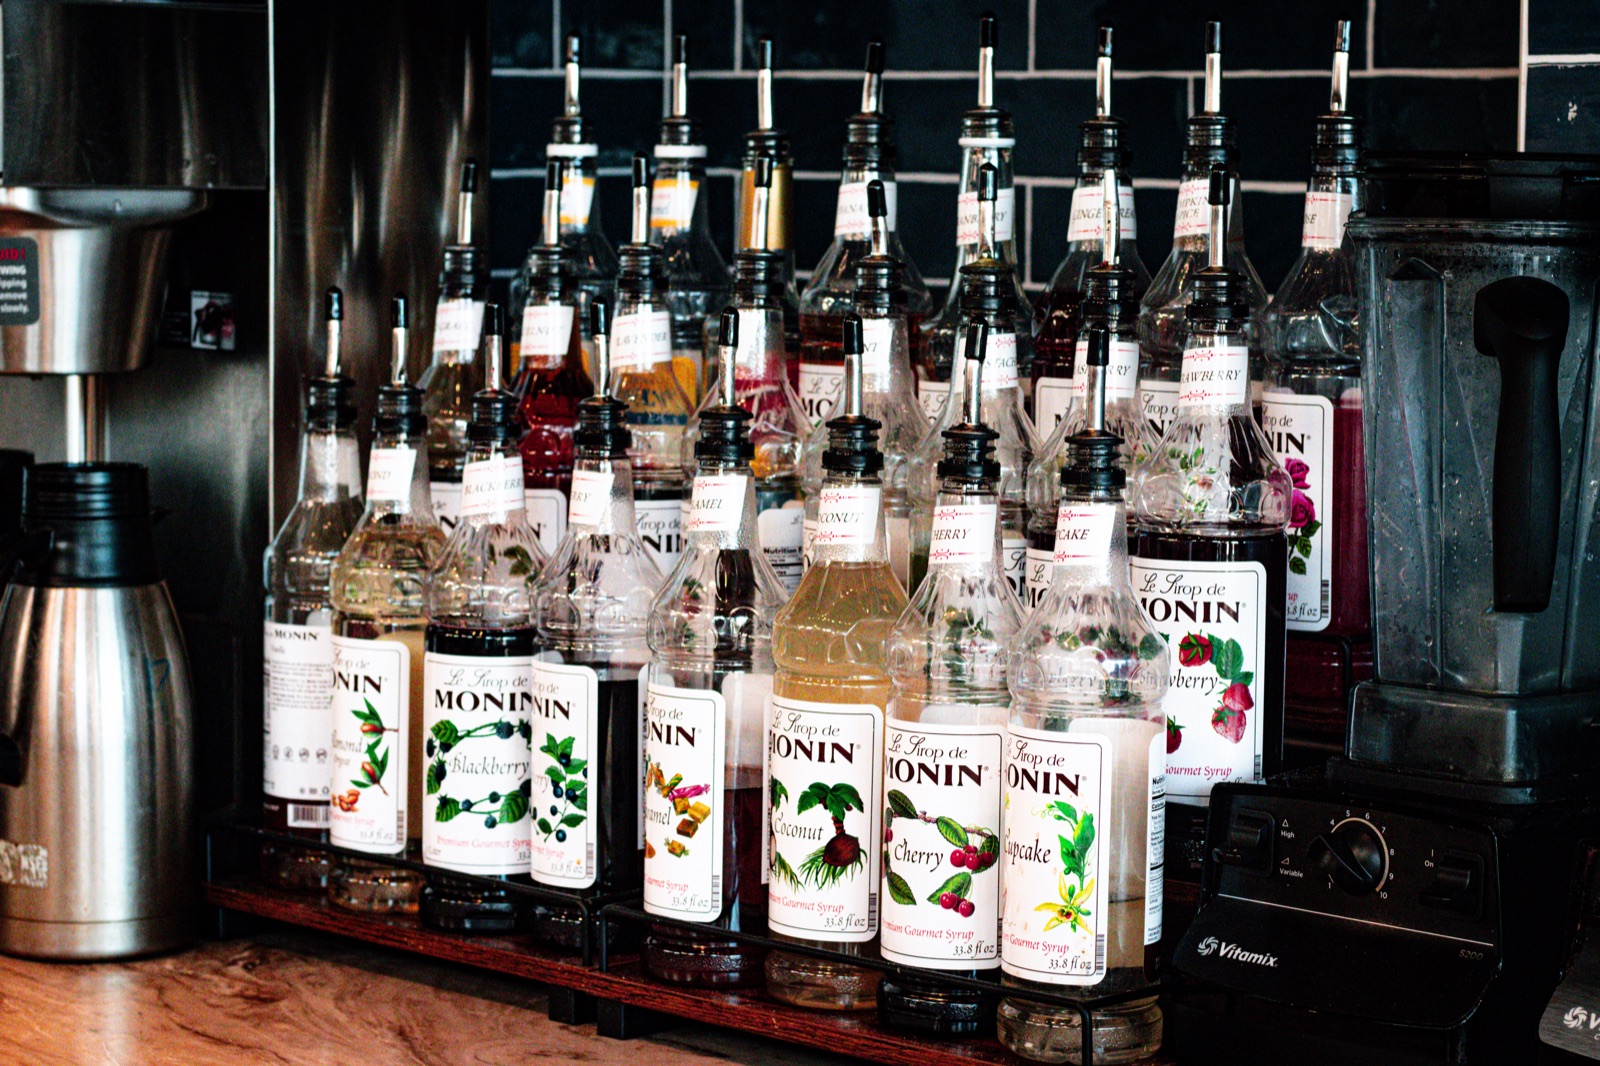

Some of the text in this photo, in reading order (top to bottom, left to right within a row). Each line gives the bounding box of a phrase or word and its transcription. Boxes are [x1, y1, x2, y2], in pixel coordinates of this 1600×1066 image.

[1181, 369, 1242, 383] RAWBERRY
[1279, 415, 1293, 428] de
[1139, 572, 1226, 601] Le Sirop de
[274, 629, 319, 641] MONIN
[444, 665, 529, 693] Le Sirop de
[669, 708, 684, 720] de
[783, 711, 818, 740] Sirop
[822, 724, 840, 737] de
[888, 733, 968, 763] Le Sirop de
[1013, 739, 1043, 770] Sirop
[1046, 753, 1065, 767] de
[449, 750, 531, 780] Blackberry
[1204, 765, 1233, 781] Syrup
[1007, 762, 1080, 797] ONIN
[1365, 812, 1370, 820] 6
[774, 812, 824, 841] Coconut
[1280, 830, 1295, 839] High
[1381, 826, 1386, 834] 7
[894, 838, 943, 873] Cherry
[1424, 860, 1434, 868] On
[1279, 867, 1304, 878] Variable
[1389, 872, 1394, 880] 9
[1379, 891, 1388, 899] 10
[782, 896, 815, 911] Gourmet
[816, 901, 844, 917] Syrup
[825, 916, 843, 928] 33.8
[855, 919, 866, 927] oz
[904, 925, 943, 939] Gourmet
[945, 928, 974, 944] Syrup
[953, 940, 995, 958] 33.8 fl oz
[1009, 934, 1040, 950] Gourmet
[1041, 940, 1070, 957] Syrup
[1218, 941, 1277, 967] Vitamix
[1048, 955, 1092, 974] 33.8 fl oz
